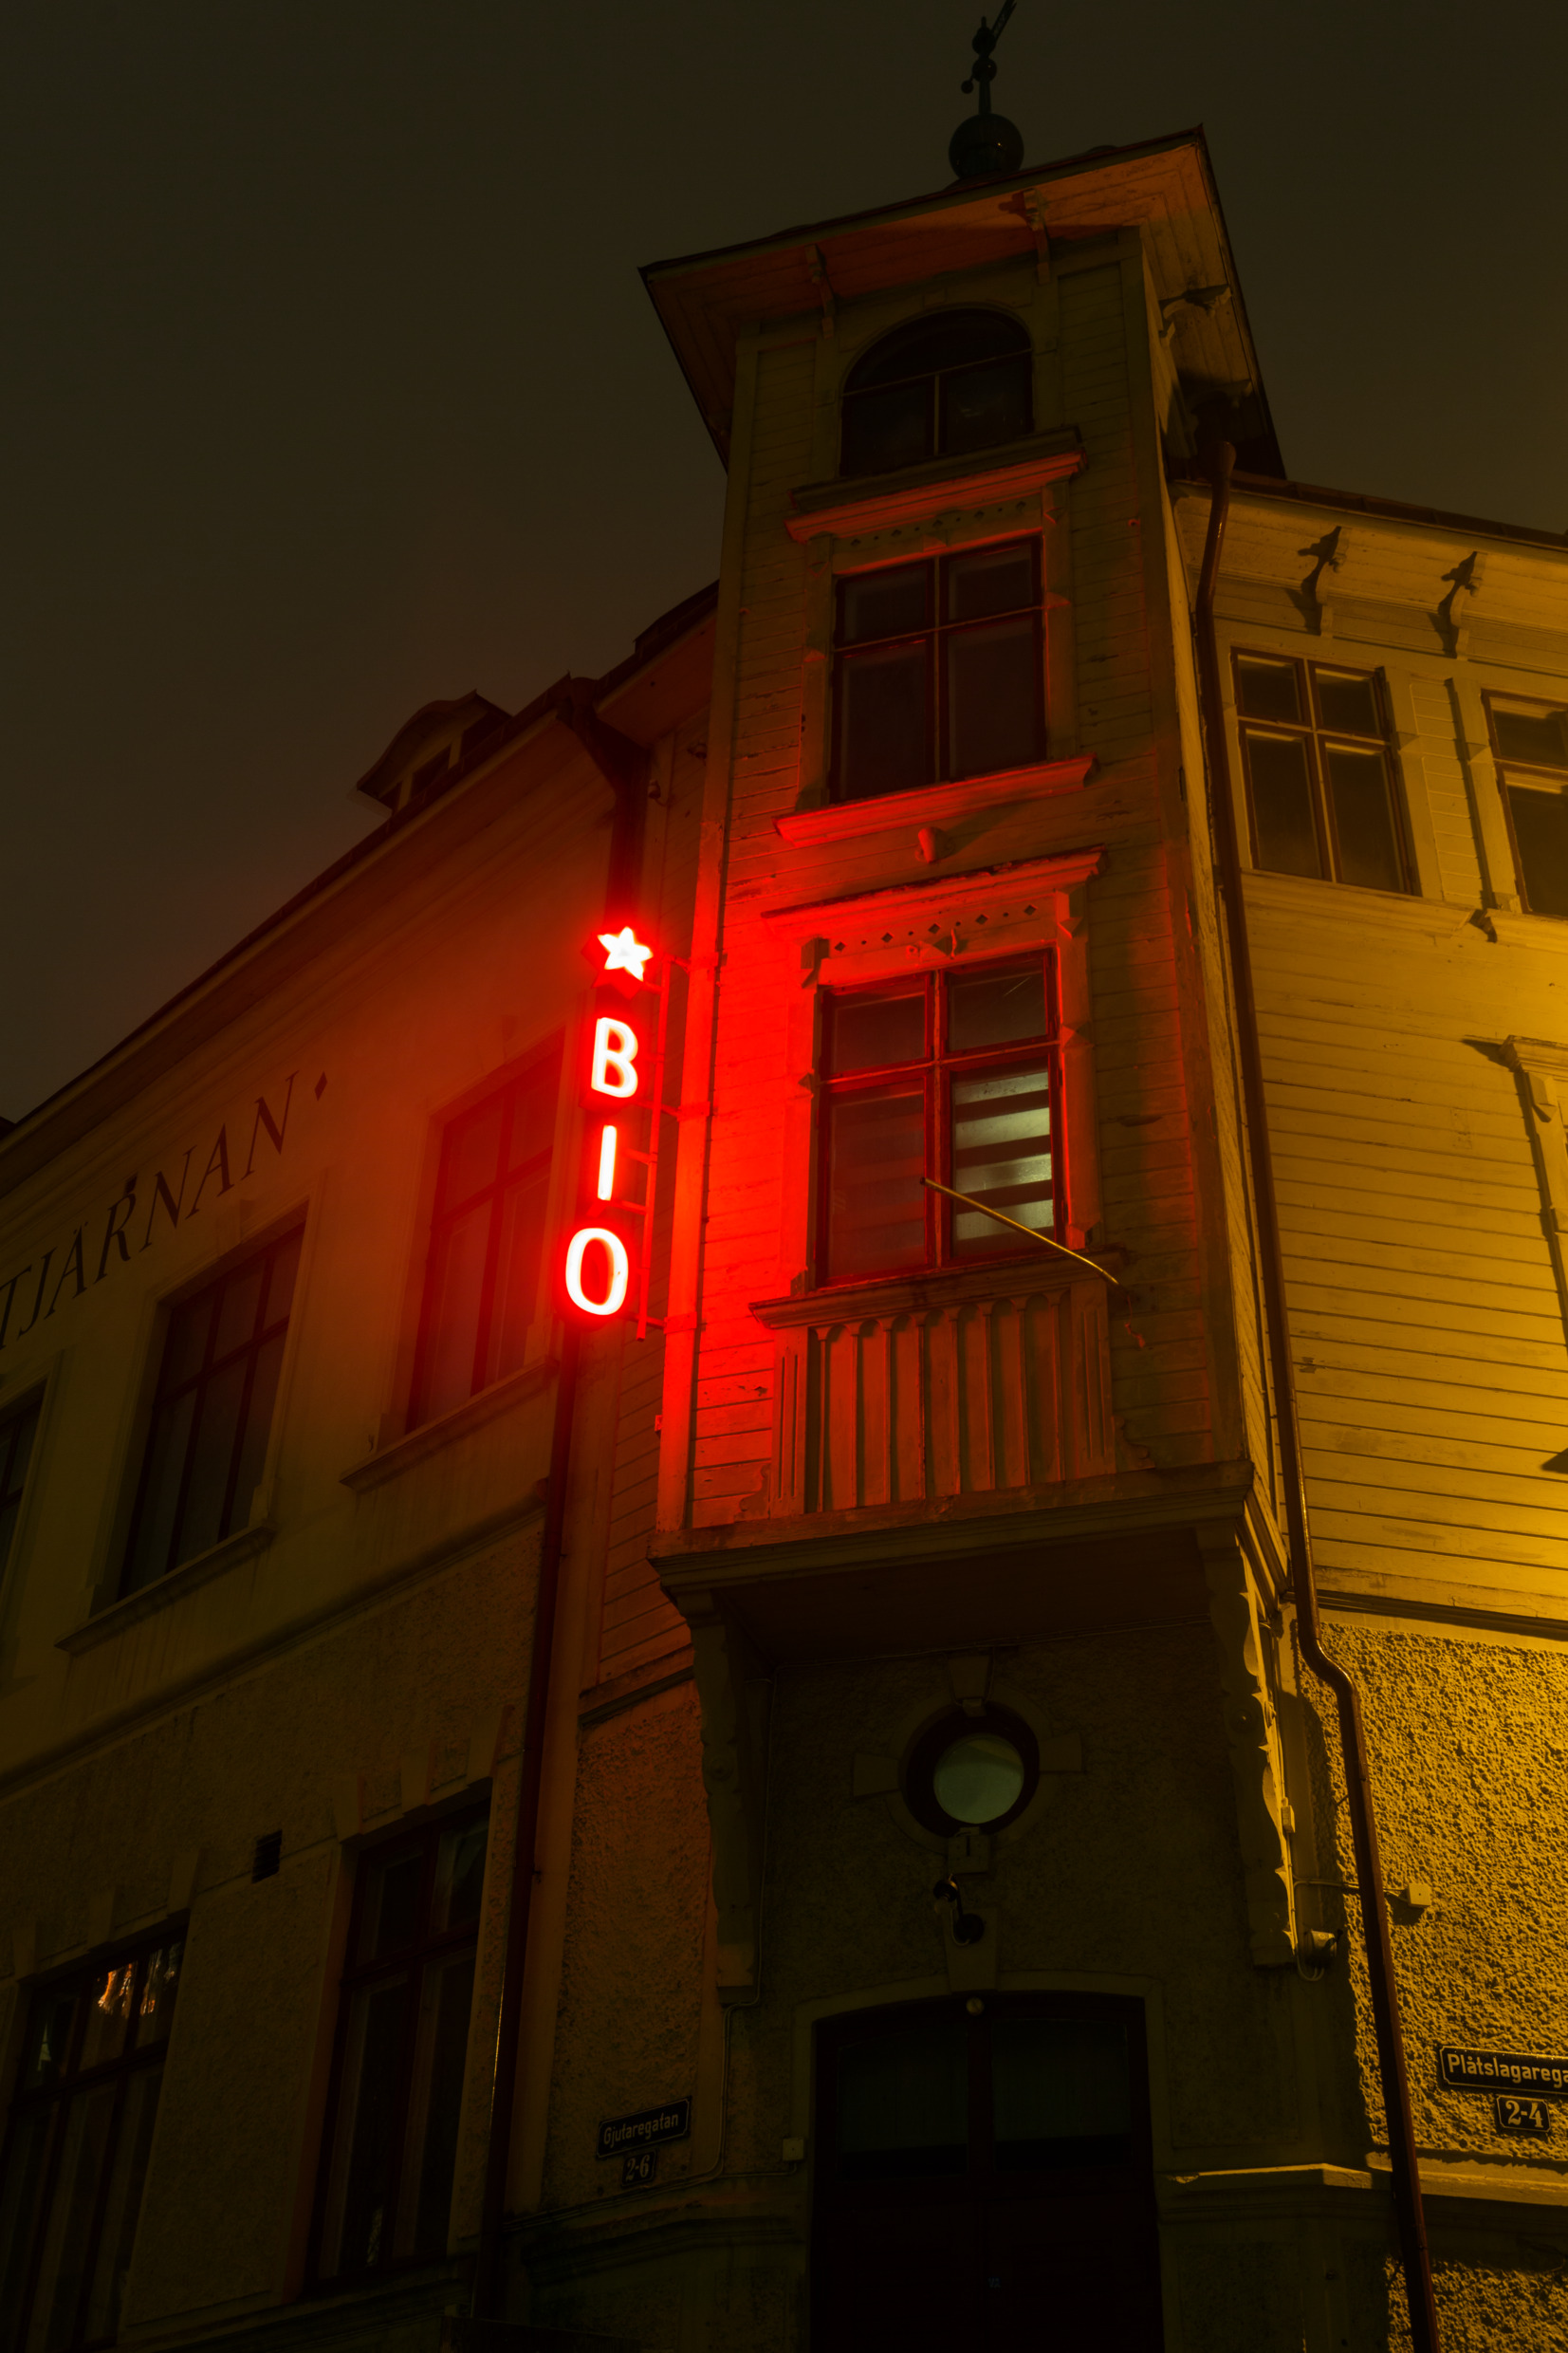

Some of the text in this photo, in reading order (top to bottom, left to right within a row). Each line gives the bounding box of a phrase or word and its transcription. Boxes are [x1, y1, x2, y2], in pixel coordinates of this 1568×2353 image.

[565, 1017, 639, 1316] BIO
[1505, 2101, 1544, 2128] 2-4
[603, 2113, 679, 2148] Gjutaregatan
[626, 2155, 651, 2181] 2-6
